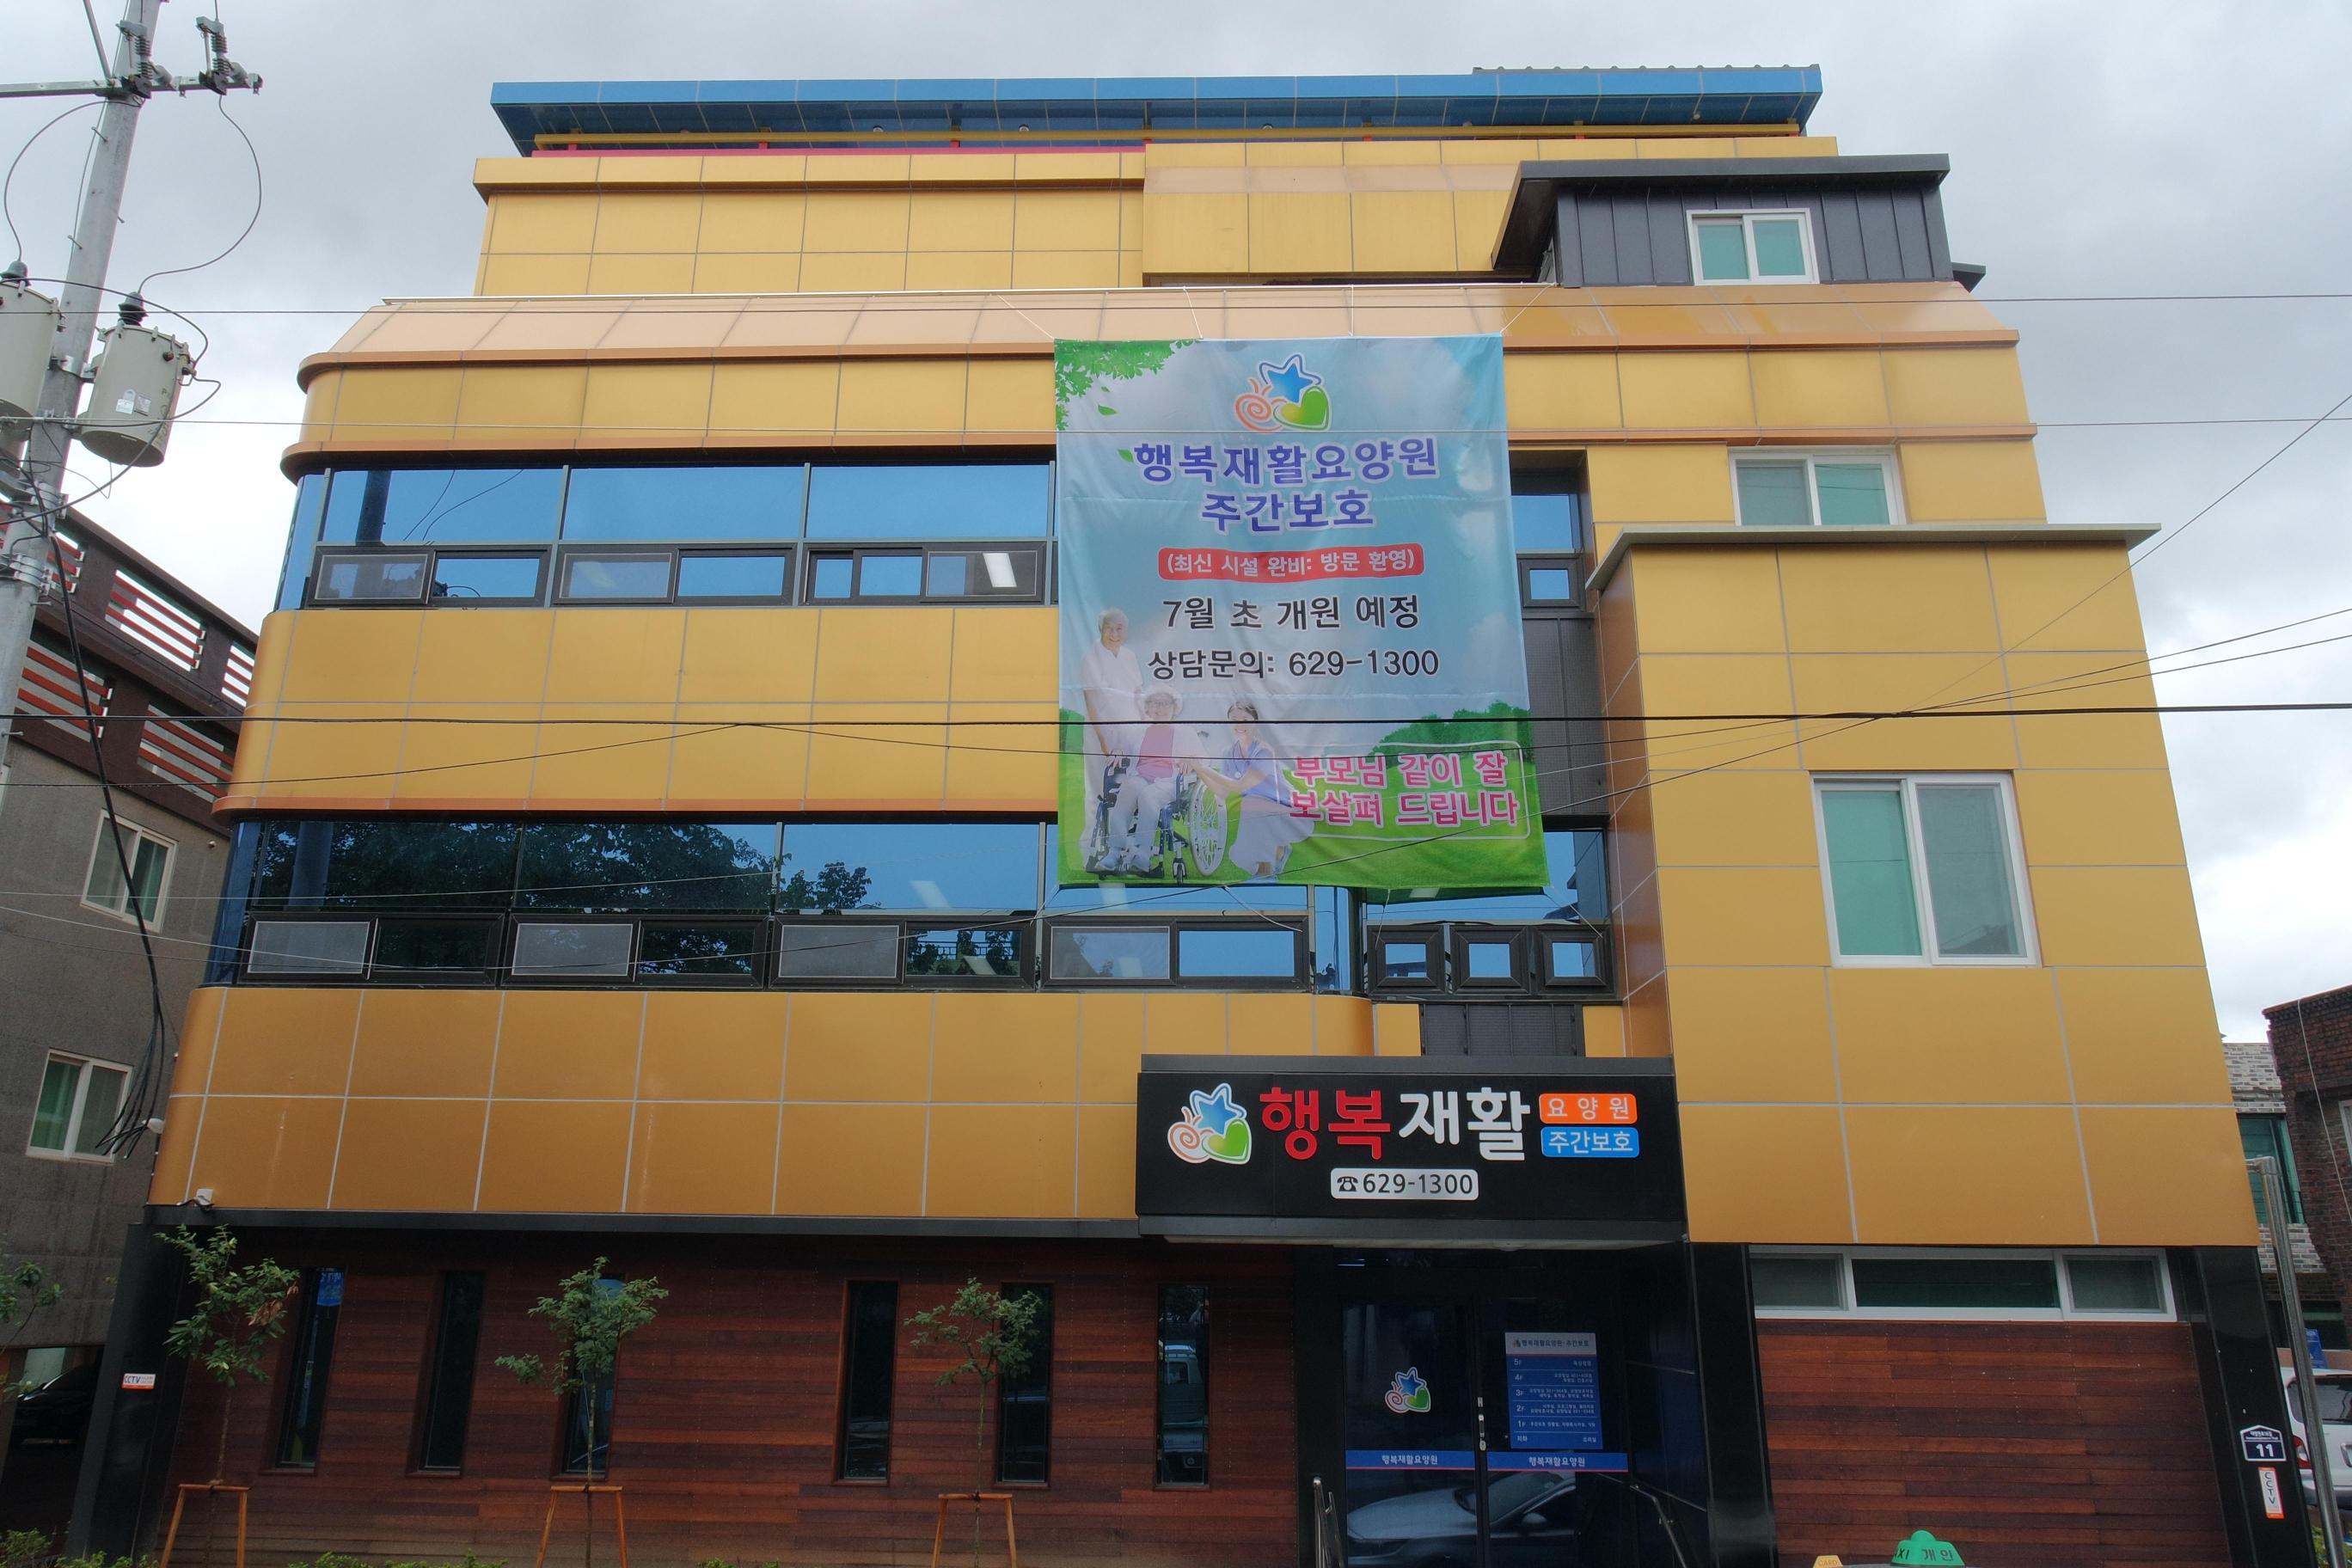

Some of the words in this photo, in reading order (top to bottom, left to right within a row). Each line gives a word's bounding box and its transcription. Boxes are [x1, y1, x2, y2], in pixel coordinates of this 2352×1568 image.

[1134, 438, 1439, 485] 행복재활요양원
[1201, 488, 1374, 533] 주간보호
[1167, 550, 1214, 576] (최신
[1221, 554, 1259, 576] 시설
[1267, 554, 1313, 578] 완비:
[1320, 550, 1360, 573] 방문
[1369, 548, 1416, 573] 환영)
[1162, 597, 1215, 629] 7월
[1231, 600, 1263, 628] 초
[1277, 597, 1341, 631] 개원
[1356, 595, 1419, 629] 예정
[1148, 649, 1275, 680] 상담문의:
[1289, 648, 1440, 677] 629-1300
[1293, 755, 1386, 788] 부모님
[1398, 752, 1461, 787] 같이
[1475, 750, 1509, 786] 잘
[1289, 790, 1384, 827] 보살펴
[1396, 791, 1519, 827] 드립니다
[1547, 1130, 1634, 1155] 주간보호
[1362, 1173, 1475, 1195] 629-1300
[1381, 1455, 1438, 1466] 행복재활요양원
[1528, 1456, 1585, 1467] 행복재활요양원
[2256, 1443, 2275, 1458] 11
[2264, 1472, 2275, 1504] CCTV
[1921, 1548, 1954, 1561] 개인
